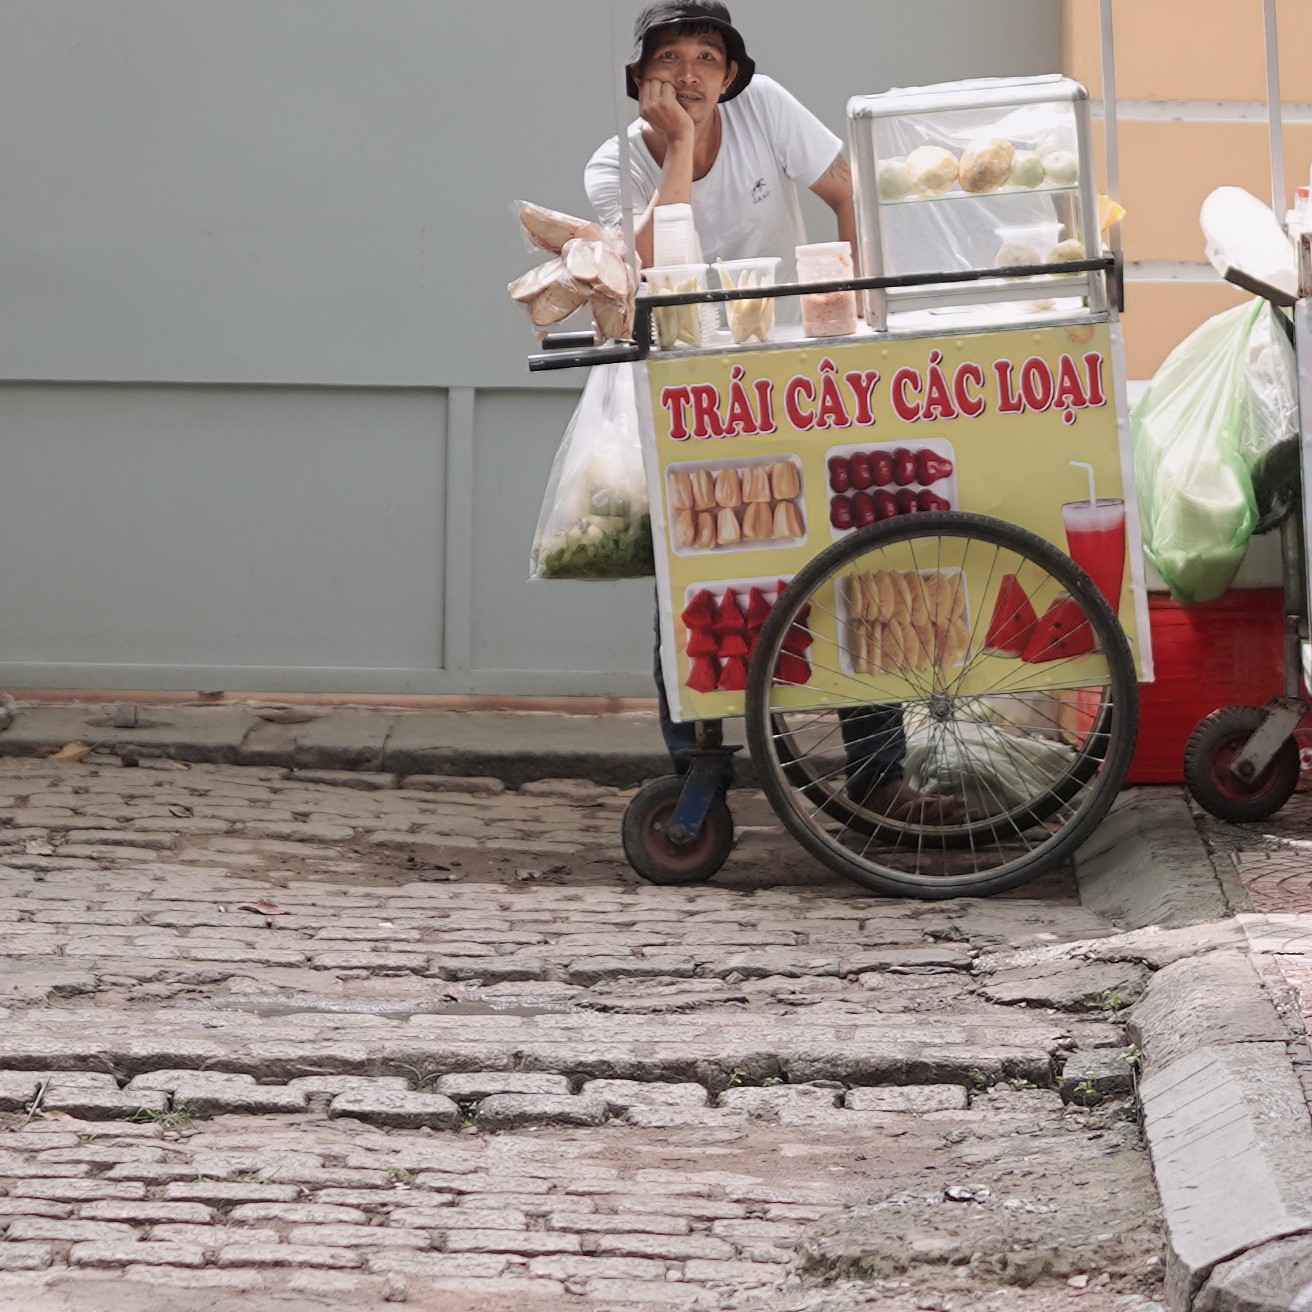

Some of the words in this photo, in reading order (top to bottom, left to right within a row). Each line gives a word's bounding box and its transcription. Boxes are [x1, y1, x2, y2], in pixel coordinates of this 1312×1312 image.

[661, 365, 777, 440] TRÁI
[784, 358, 879, 430] CÂY
[890, 349, 985, 422] CÁC
[992, 352, 1106, 424] LOẠI
